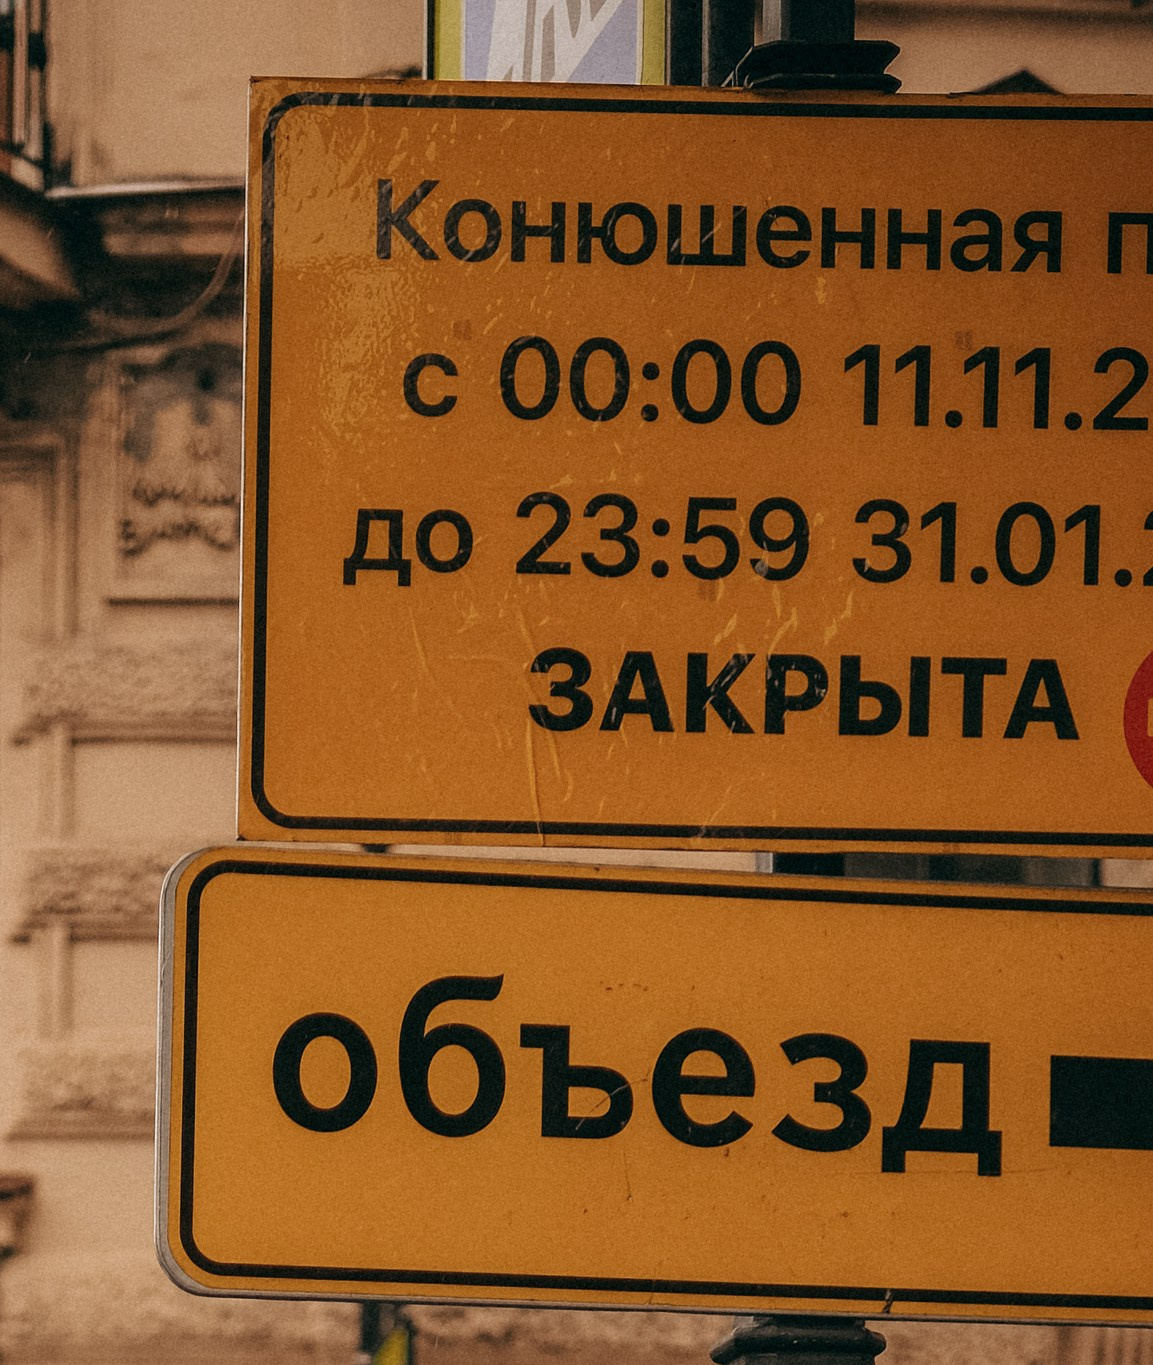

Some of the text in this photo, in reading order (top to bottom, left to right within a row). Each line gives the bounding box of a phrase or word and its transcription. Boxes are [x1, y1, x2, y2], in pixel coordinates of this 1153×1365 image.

[376, 179, 1064, 275] Конюшенная
[402, 335, 1151, 432] с 00:00 11.11.2
[342, 491, 1153, 589] до 23:59 31.01.
[527, 646, 1081, 741] ЗАКРЫТА
[271, 974, 1003, 1178] объезд
